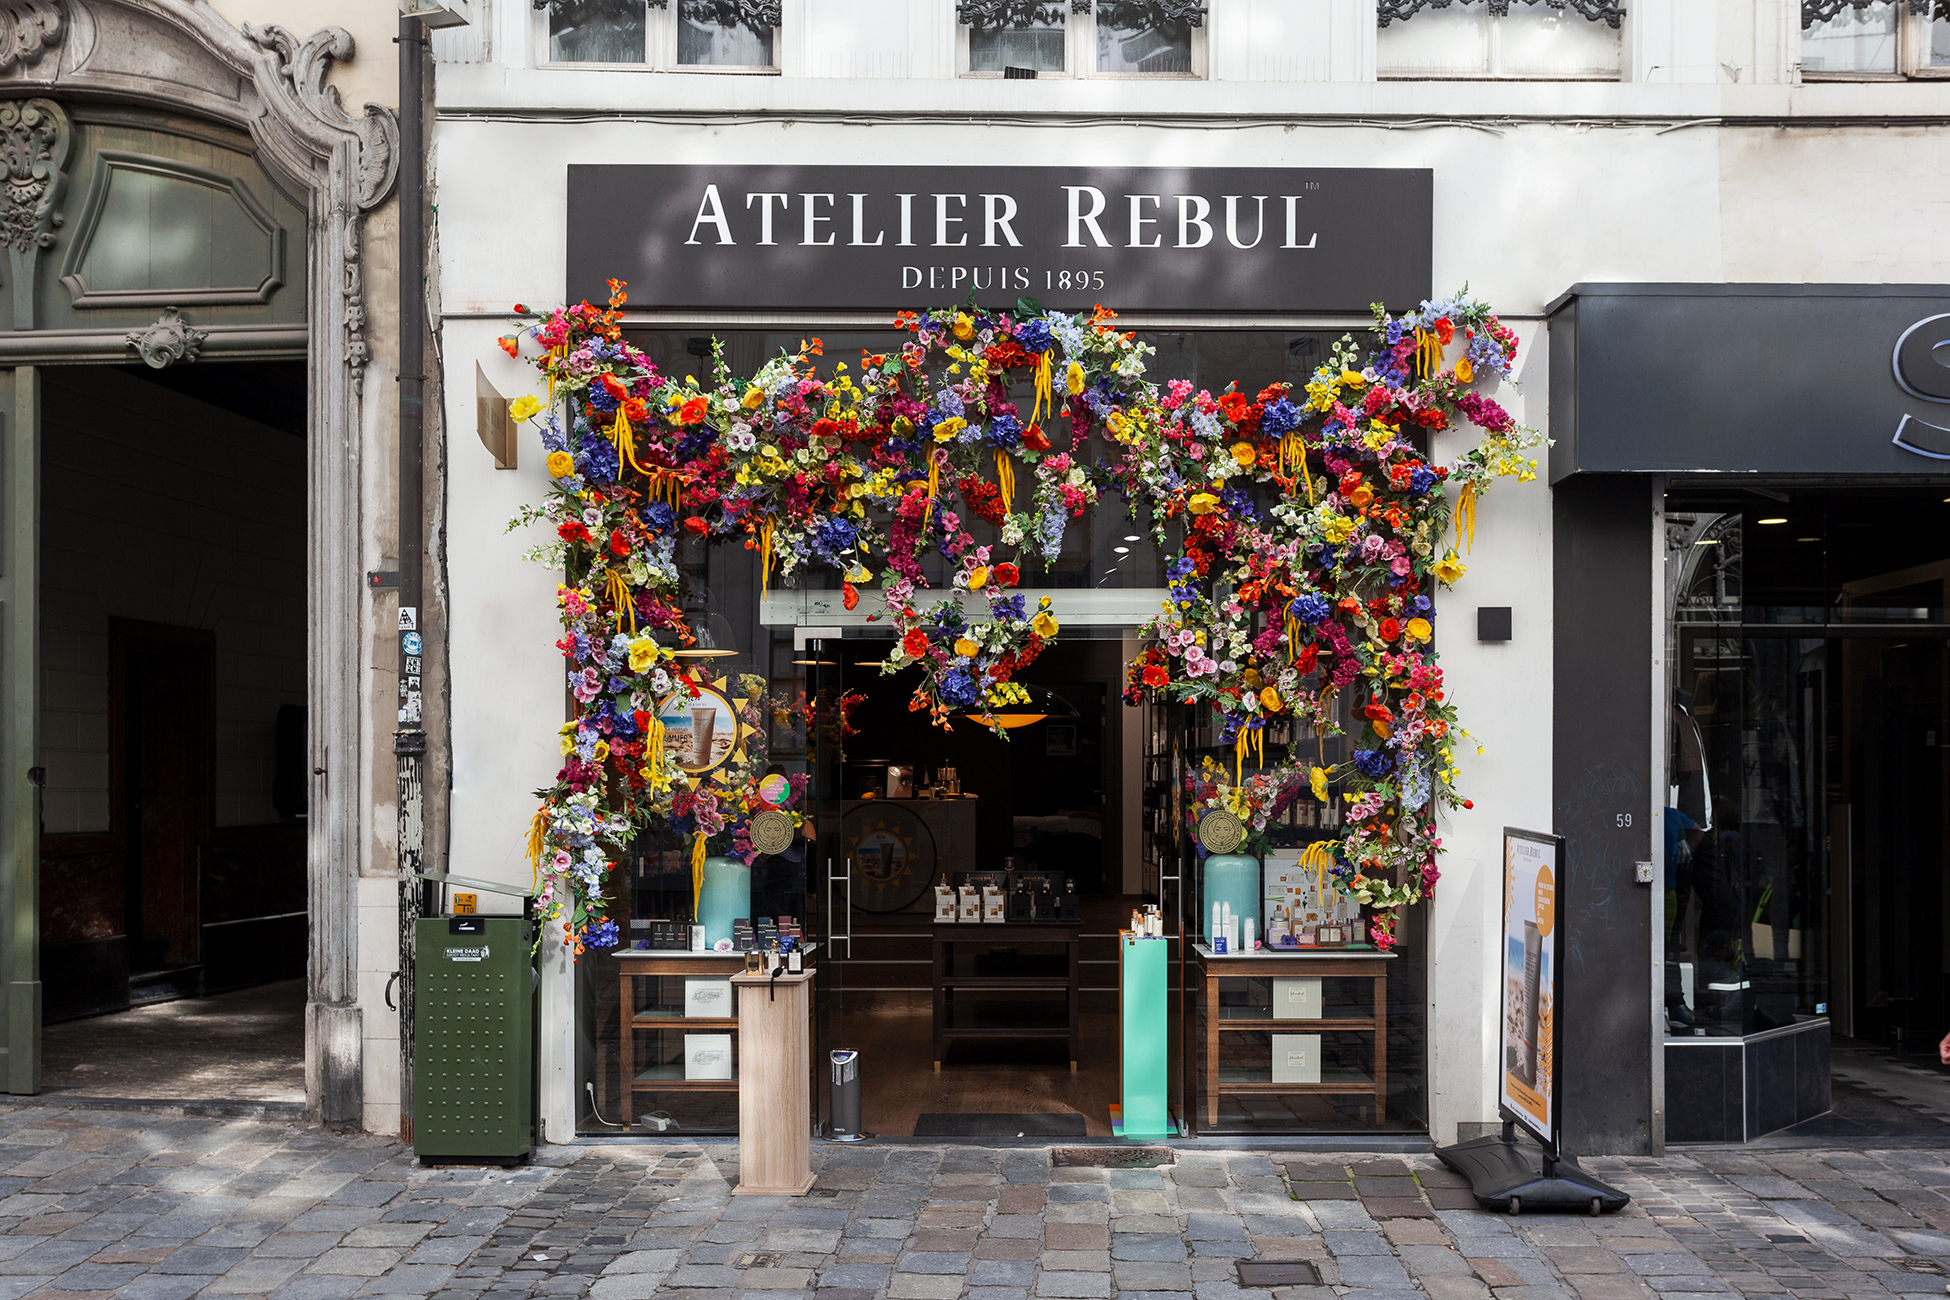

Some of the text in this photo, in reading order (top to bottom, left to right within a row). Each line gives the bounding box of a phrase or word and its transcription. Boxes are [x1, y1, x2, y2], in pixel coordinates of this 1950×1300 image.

[684, 183, 1024, 247] ATELIER
[1060, 185, 1318, 250] REBUL
[902, 266, 1105, 291] DEPUIS 1895
[1616, 813, 1632, 828] 59
